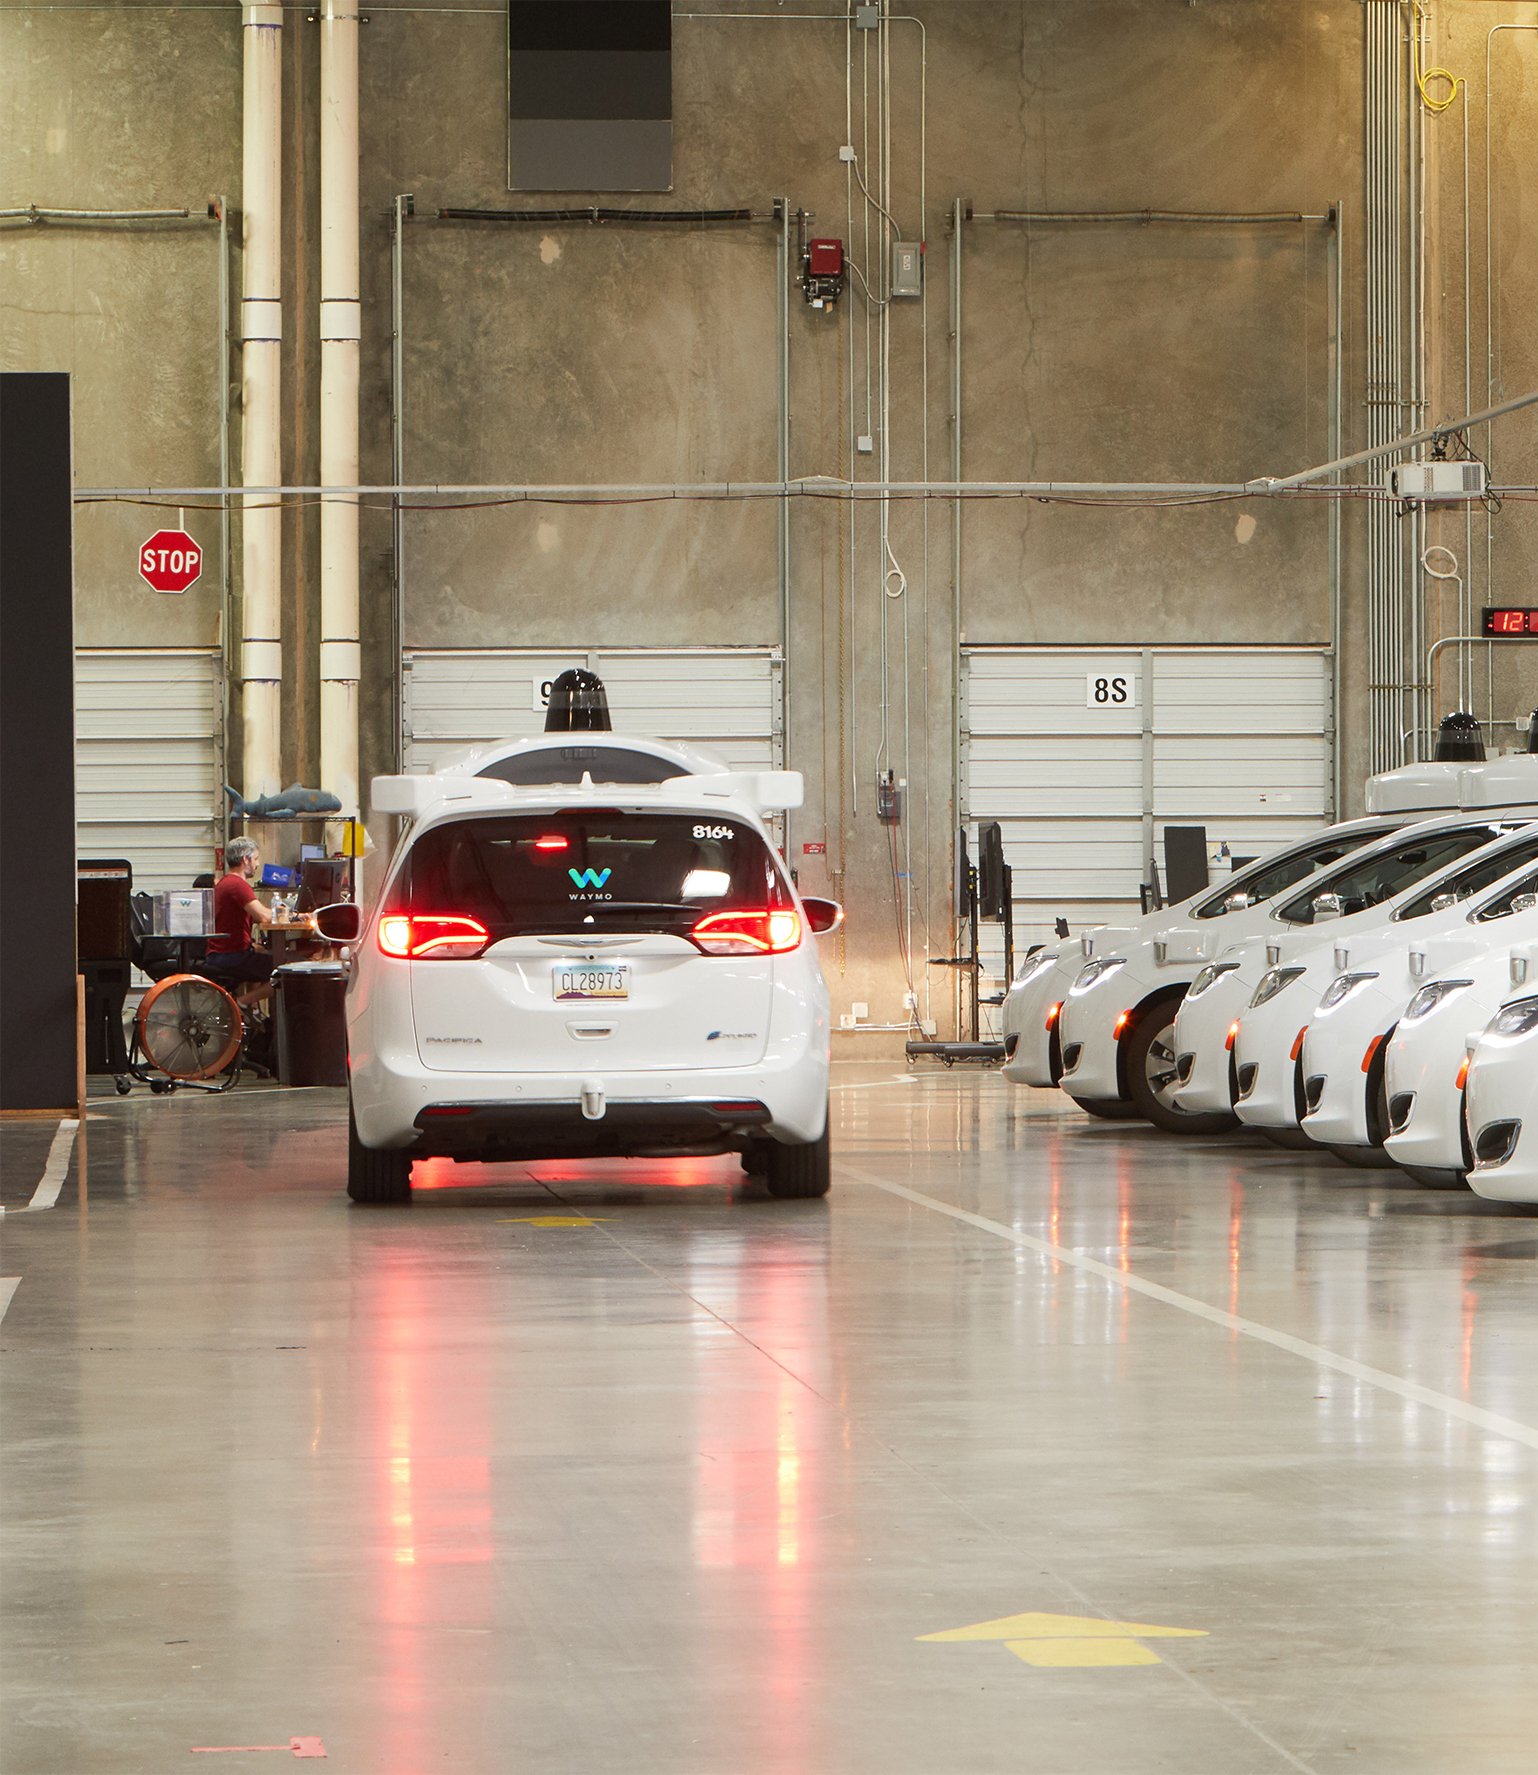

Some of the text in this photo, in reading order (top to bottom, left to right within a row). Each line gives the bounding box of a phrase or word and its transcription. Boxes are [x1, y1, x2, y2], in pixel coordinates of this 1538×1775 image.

[143, 549, 199, 574] STOP
[1094, 677, 1127, 703] 8S
[692, 825, 735, 839] 8164
[568, 893, 613, 901] WAYMO
[562, 972, 623, 991] CL28973
